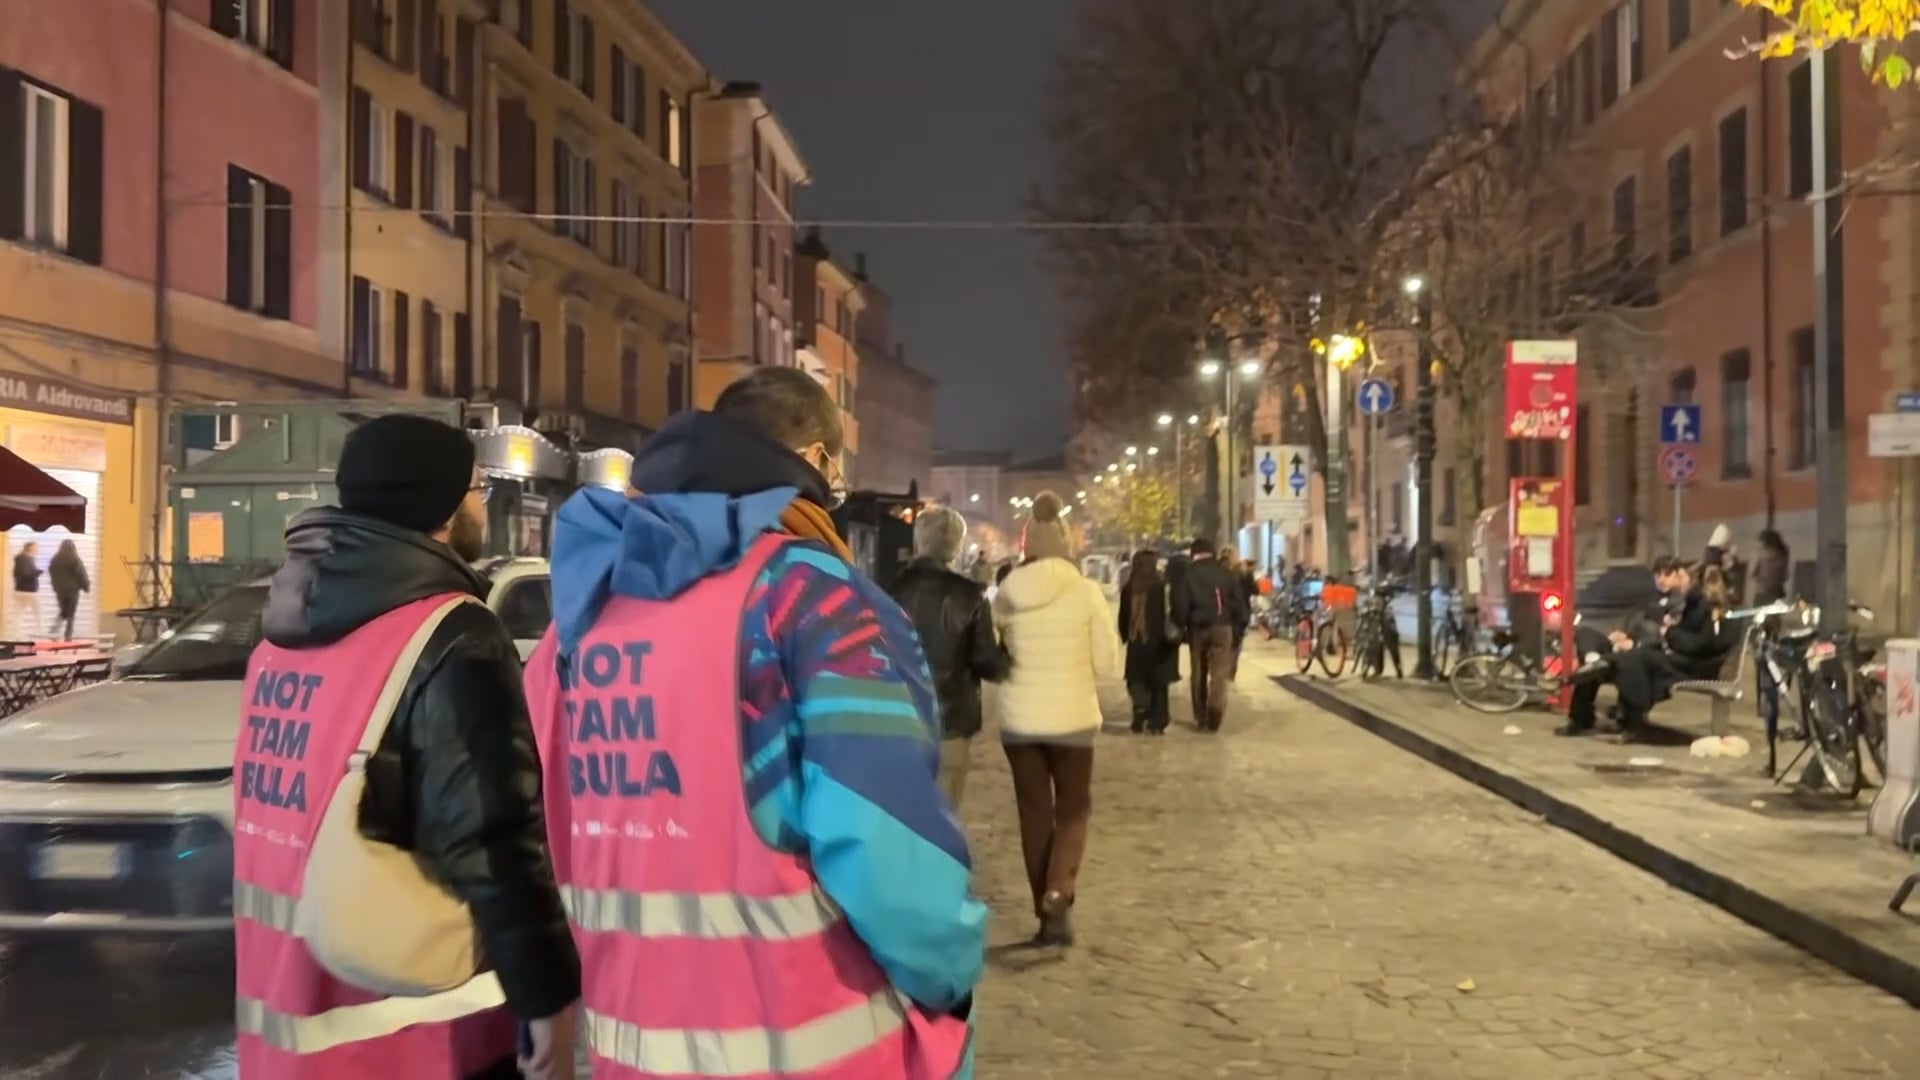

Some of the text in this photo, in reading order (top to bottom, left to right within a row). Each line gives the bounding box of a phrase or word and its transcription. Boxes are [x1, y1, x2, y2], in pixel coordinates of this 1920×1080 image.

[36, 385, 128, 416] Aldrovandi
[252, 671, 323, 712] NOT
[248, 716, 311, 760] TAM
[241, 761, 307, 813] BULA
[570, 751, 681, 797] BULA
